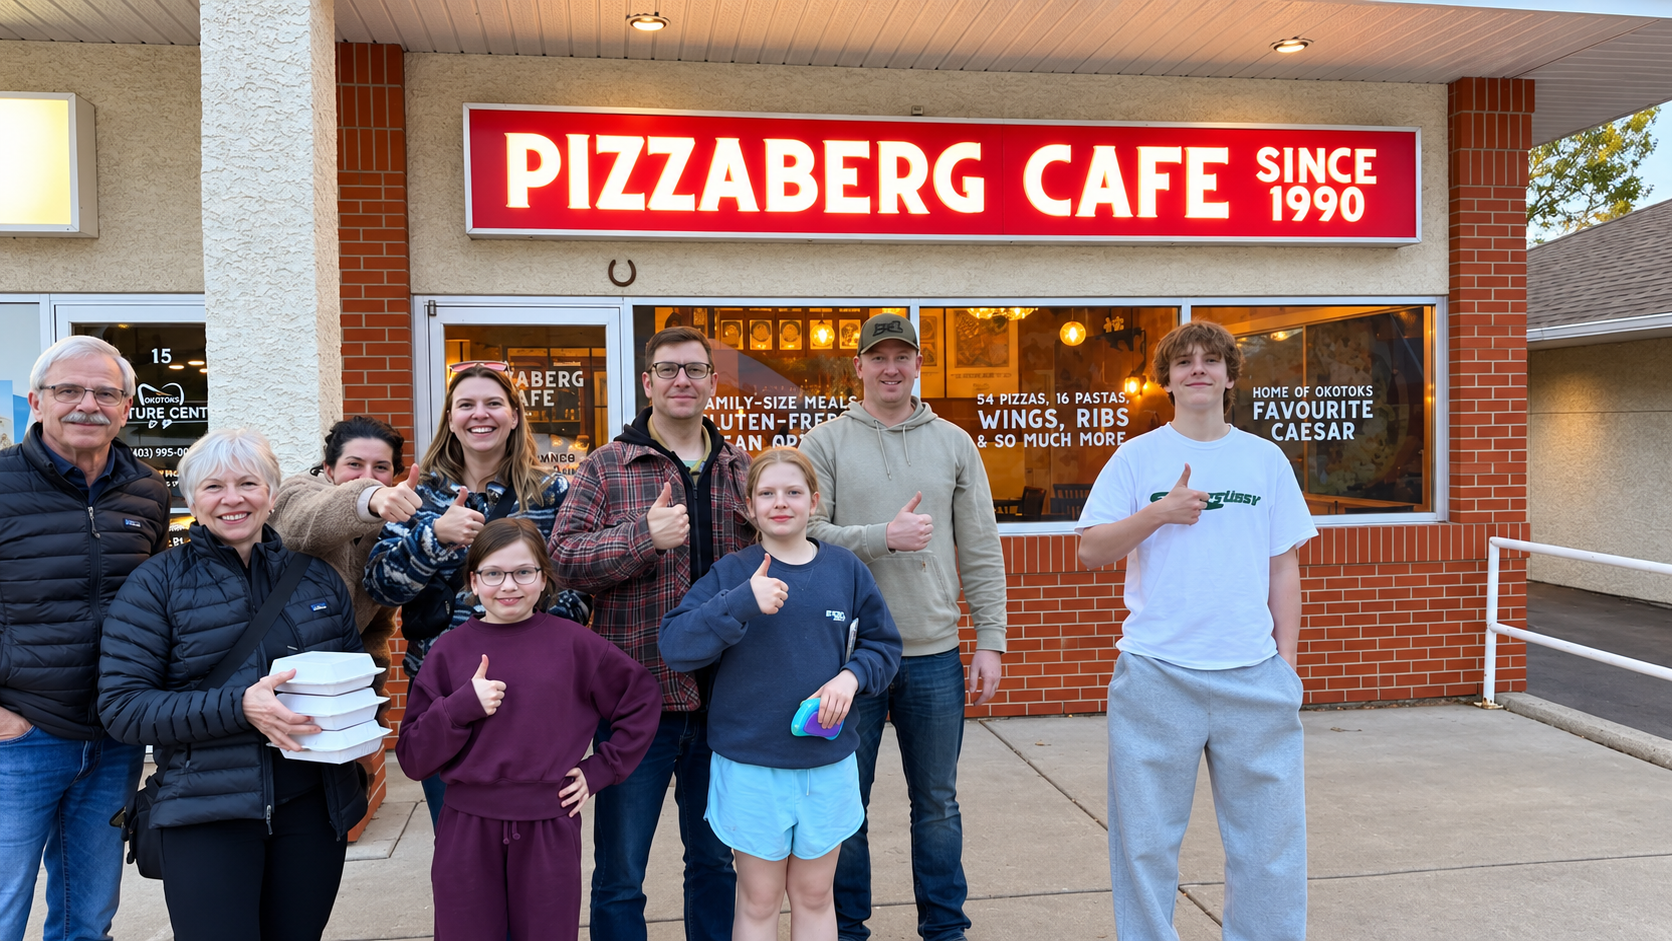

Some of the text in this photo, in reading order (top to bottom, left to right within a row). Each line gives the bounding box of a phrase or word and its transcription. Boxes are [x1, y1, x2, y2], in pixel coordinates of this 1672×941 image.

[1256, 146, 1377, 185] SINCE
[504, 132, 1229, 218] PIZZABERG CAFE
[1270, 186, 1365, 222] 1990
[151, 348, 172, 364] 15
[505, 370, 584, 387] ABERG
[518, 389, 555, 407] AFE
[977, 391, 1130, 406] 54 PIZZAS, 16 PASTAS,
[1253, 385, 1373, 398] HOME OF OKOTOKS
[704, 395, 797, 410] AMILY-SIZE
[1253, 400, 1374, 420] FAVOURITE
[128, 406, 208, 419] TURE CENT
[977, 407, 1129, 432] WINGS, RIBS
[703, 412, 837, 431] UTEN-FRE
[977, 431, 1127, 448] & SO MUCH MORE
[1271, 421, 1355, 441] CAESAR
[131, 447, 189, 459] 403) 995-00
